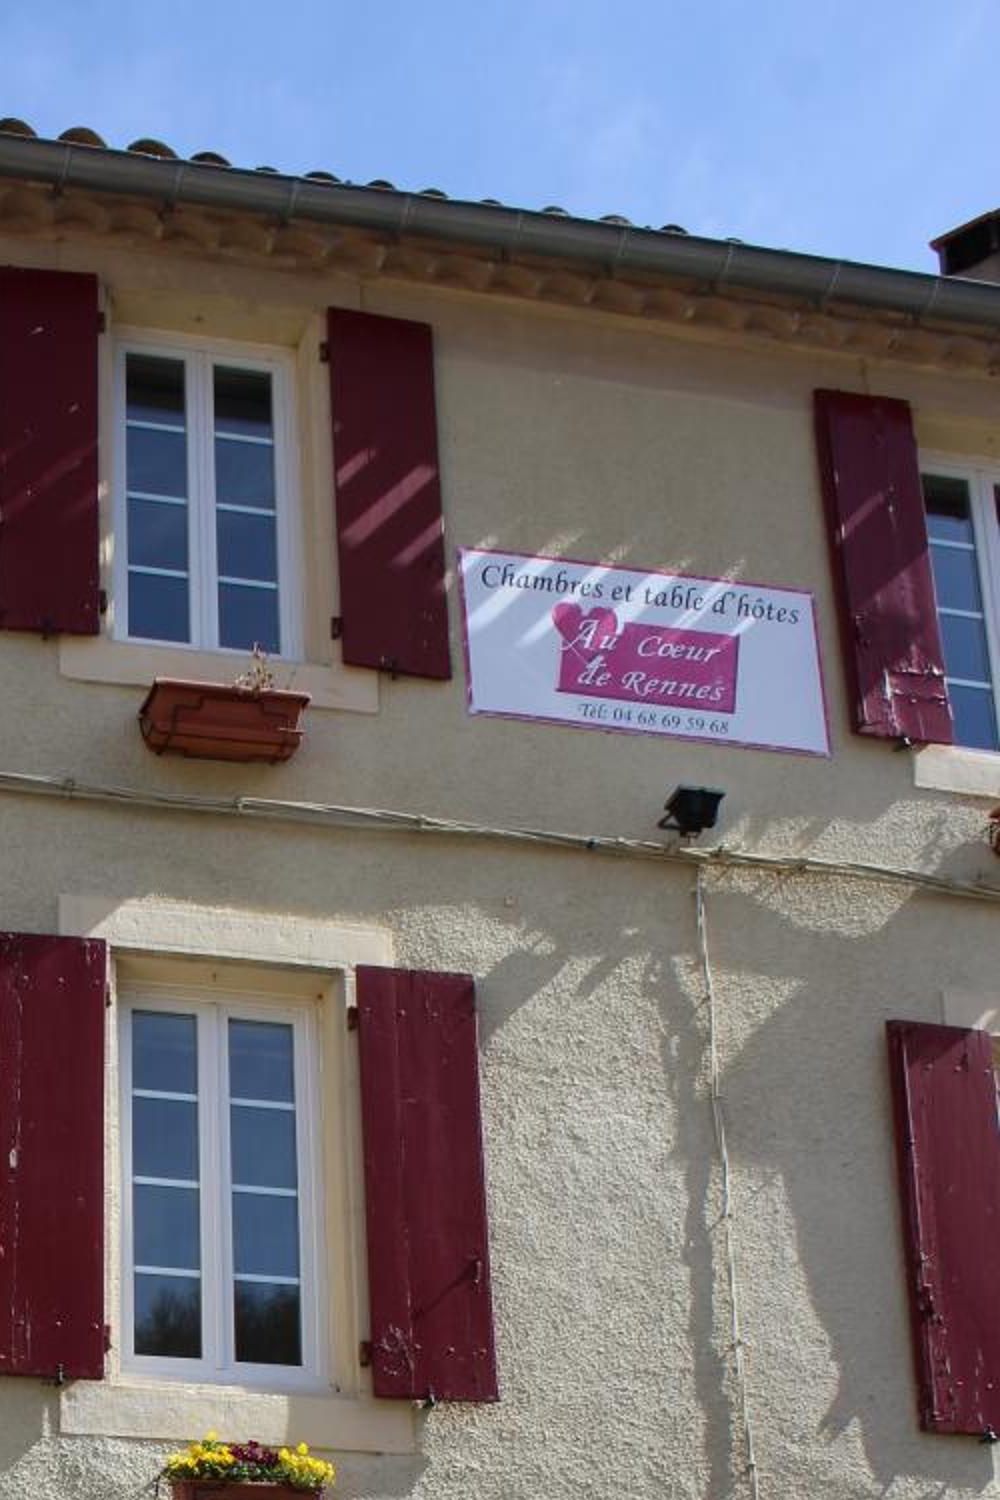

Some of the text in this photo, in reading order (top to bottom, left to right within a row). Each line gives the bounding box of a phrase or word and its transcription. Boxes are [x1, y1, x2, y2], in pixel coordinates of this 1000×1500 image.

[481, 563, 604, 599] Chambres
[611, 584, 632, 602] et
[644, 585, 704, 611] table
[560, 619, 619, 651] Au
[577, 655, 725, 700] de Rennes
[613, 707, 632, 722] 04
[637, 711, 657, 726] 68
[661, 713, 681, 728] 69
[709, 720, 729, 735] 68
